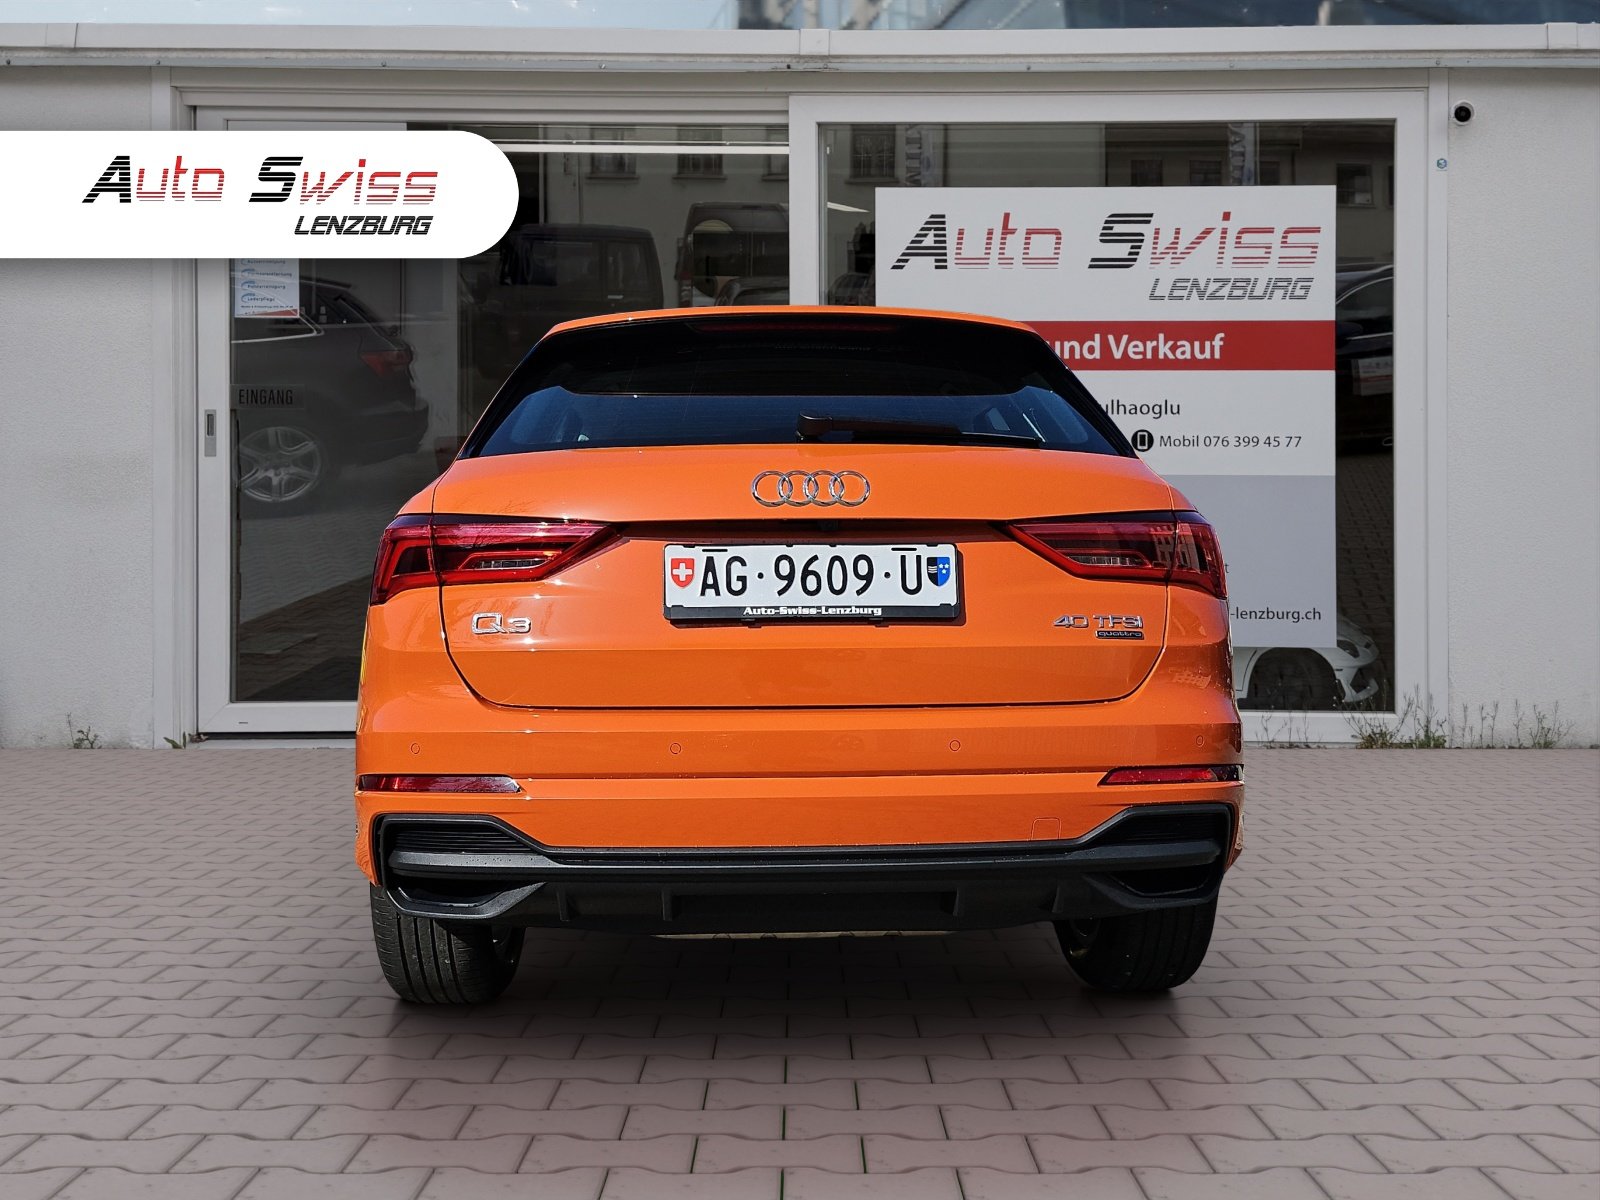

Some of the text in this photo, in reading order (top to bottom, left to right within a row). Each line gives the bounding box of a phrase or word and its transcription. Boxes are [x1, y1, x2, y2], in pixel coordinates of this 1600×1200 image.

[891, 211, 1322, 270] Auto Swiss
[1149, 277, 1315, 301] LENZBURG
[1107, 332, 1225, 360] Verkauf
[238, 388, 293, 405] EINGANG
[1159, 434, 1302, 448] Mobil 076 399 45 77
[743, 606, 882, 616] Auto-Swiss-Lenzburg
[1053, 614, 1144, 628] 40 TFSI
[1098, 630, 1143, 638] quattro
